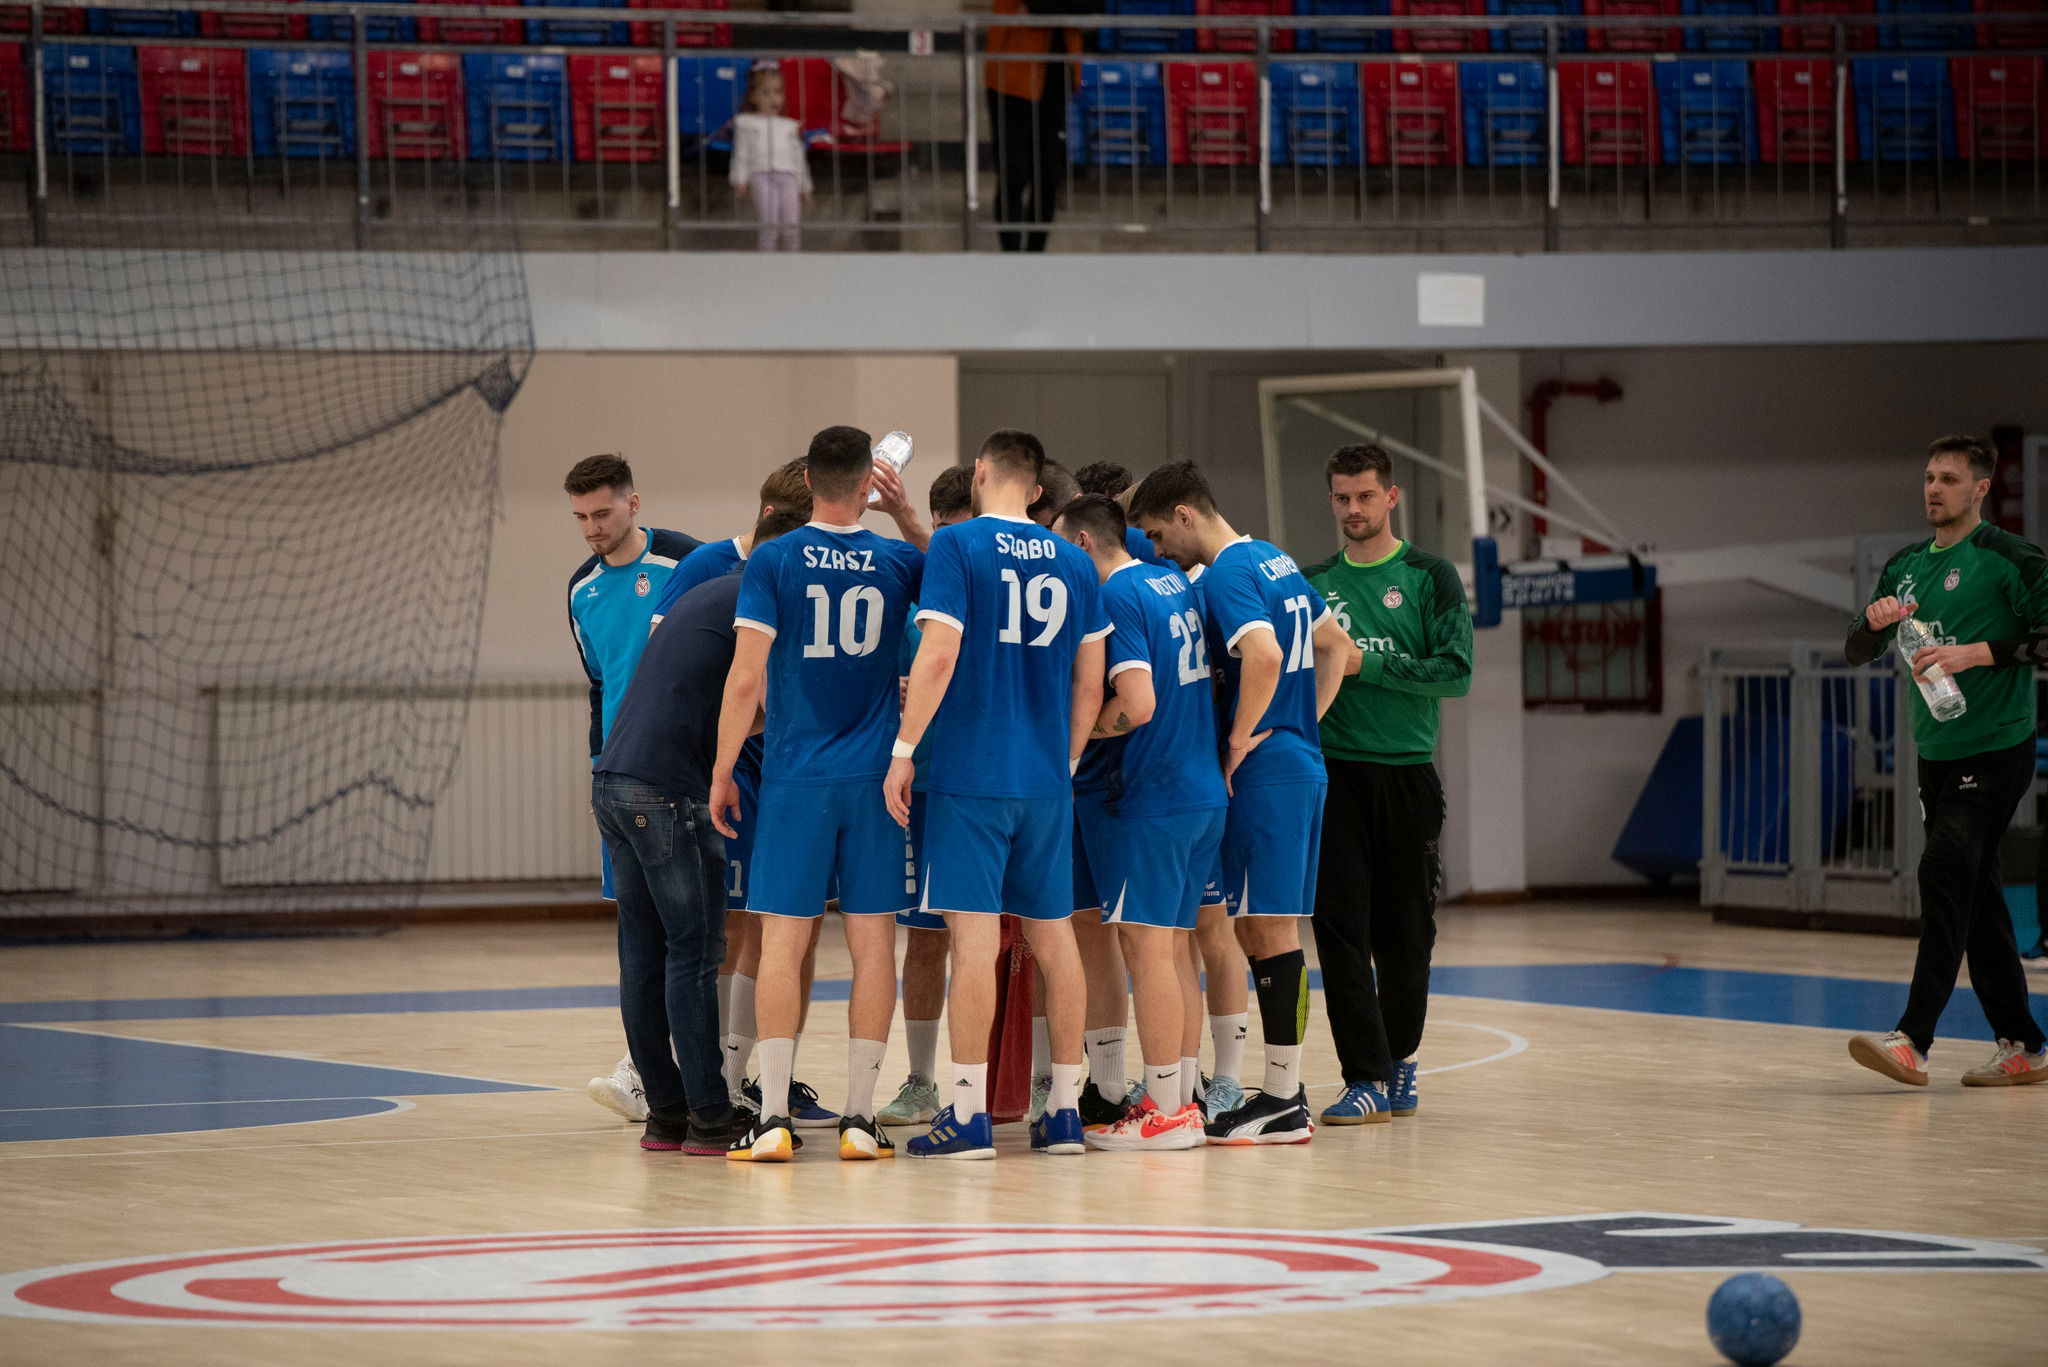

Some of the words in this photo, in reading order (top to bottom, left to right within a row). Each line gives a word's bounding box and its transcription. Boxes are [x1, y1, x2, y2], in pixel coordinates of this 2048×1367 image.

[803, 545, 876, 572] SZASZ
[995, 532, 1056, 560] SZABO
[803, 584, 885, 658] 10
[999, 568, 1068, 647] 19
[1284, 595, 1315, 673] 77
[1169, 607, 1211, 687] 22
